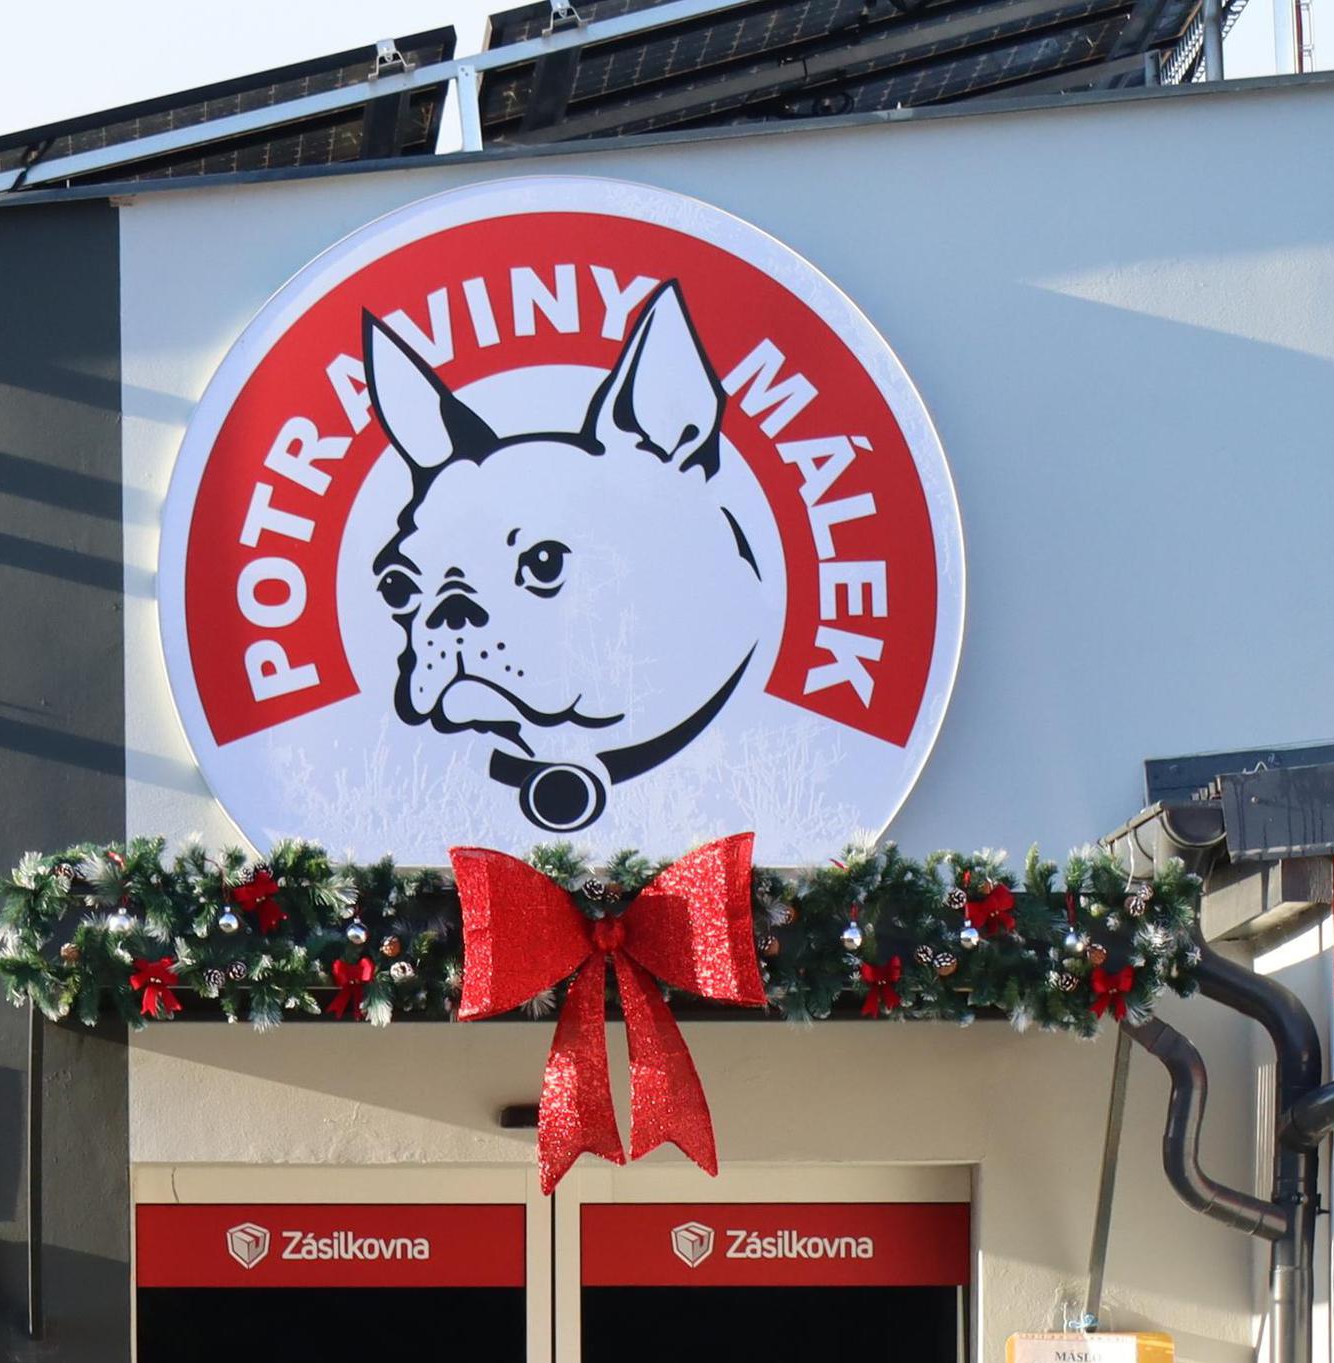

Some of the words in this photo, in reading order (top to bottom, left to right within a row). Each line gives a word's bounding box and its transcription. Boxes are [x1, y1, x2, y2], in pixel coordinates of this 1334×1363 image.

[236, 263, 661, 703] POTRAVINY
[721, 338, 890, 710] MÁLEK
[281, 1231, 430, 1260] Zásilkovna
[725, 1230, 874, 1259] Zásilkovna
